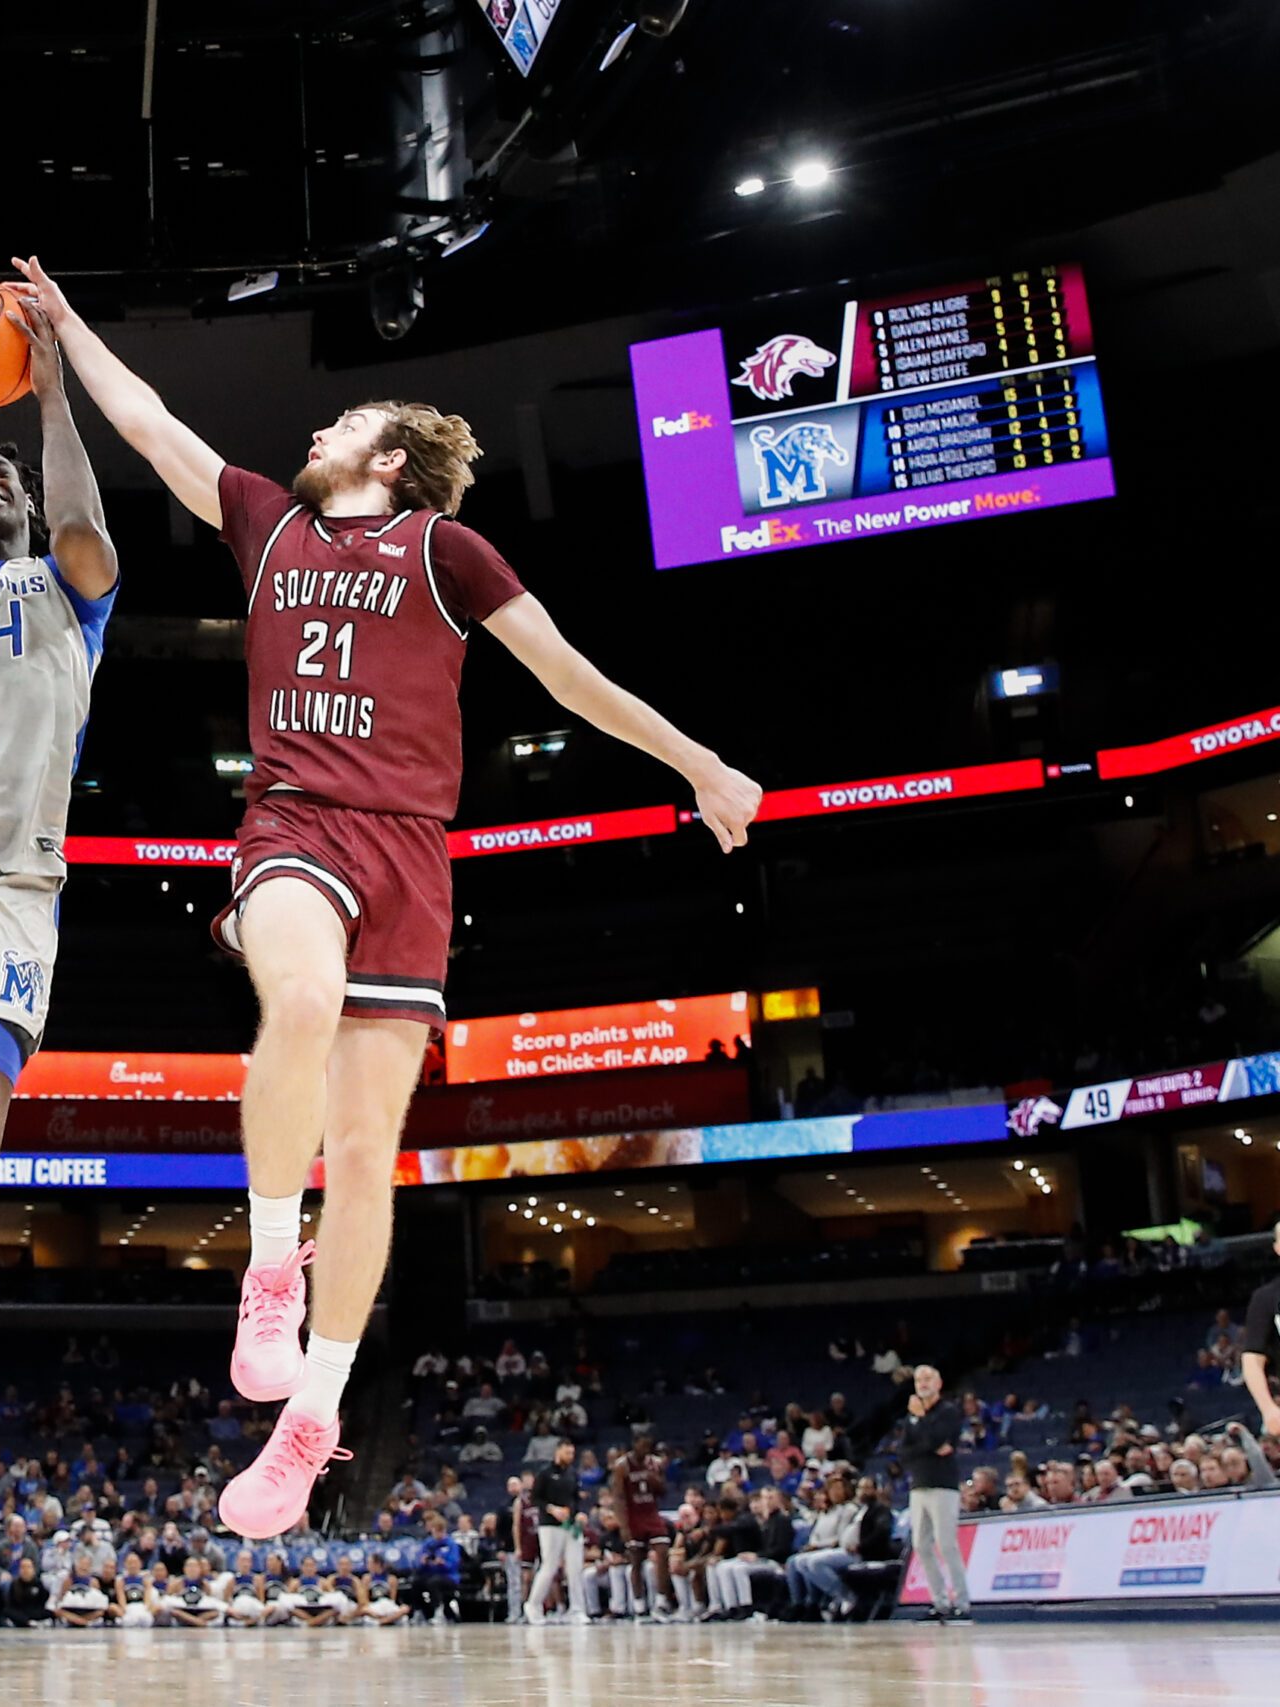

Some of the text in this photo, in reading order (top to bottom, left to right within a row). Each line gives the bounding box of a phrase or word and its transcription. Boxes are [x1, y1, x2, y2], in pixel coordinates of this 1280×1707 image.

[1047, 279, 1056, 293] 2
[1021, 300, 1030, 314] 7
[996, 321, 1006, 336] 5
[1024, 316, 1033, 331] 2
[1051, 311, 1061, 326] 3
[999, 338, 1008, 352] 4
[1026, 333, 1036, 347] 4
[1054, 327, 1063, 342] 4
[1056, 344, 1066, 358] 3
[1004, 387, 1017, 402] 15
[1064, 395, 1074, 409] 2
[653, 411, 713, 437] FedEx
[1009, 421, 1022, 435] 12
[1039, 416, 1048, 430] 4
[1066, 411, 1076, 426] 3
[1013, 438, 1022, 452] 4
[1041, 432, 1051, 447] 3
[1043, 449, 1053, 464] 5
[1071, 444, 1081, 459] 2
[721, 519, 801, 553] FedEx
[814, 518, 852, 539] The
[855, 510, 901, 531] New
[904, 497, 972, 523] Power
[273, 568, 408, 618] SOUTHERN
[296, 620, 354, 680] 21
[270, 689, 375, 739] ILLINOIS
[819, 776, 952, 808] TOYOTA.COM
[470, 821, 593, 851] TOYOTA.COM
[135, 843, 238, 862] TOYOTA.CO
[512, 1020, 674, 1052] Score points with
[506, 1045, 688, 1076] the Chick-fil-A App
[1193, 1070, 1204, 1087] 2
[576, 1101, 675, 1126] FanDeck
[1084, 1089, 1112, 1119] 49
[33, 1158, 107, 1186] COFFEE
[1001, 1523, 1073, 1553] CONWAY
[1129, 1511, 1220, 1545] CONWAY
